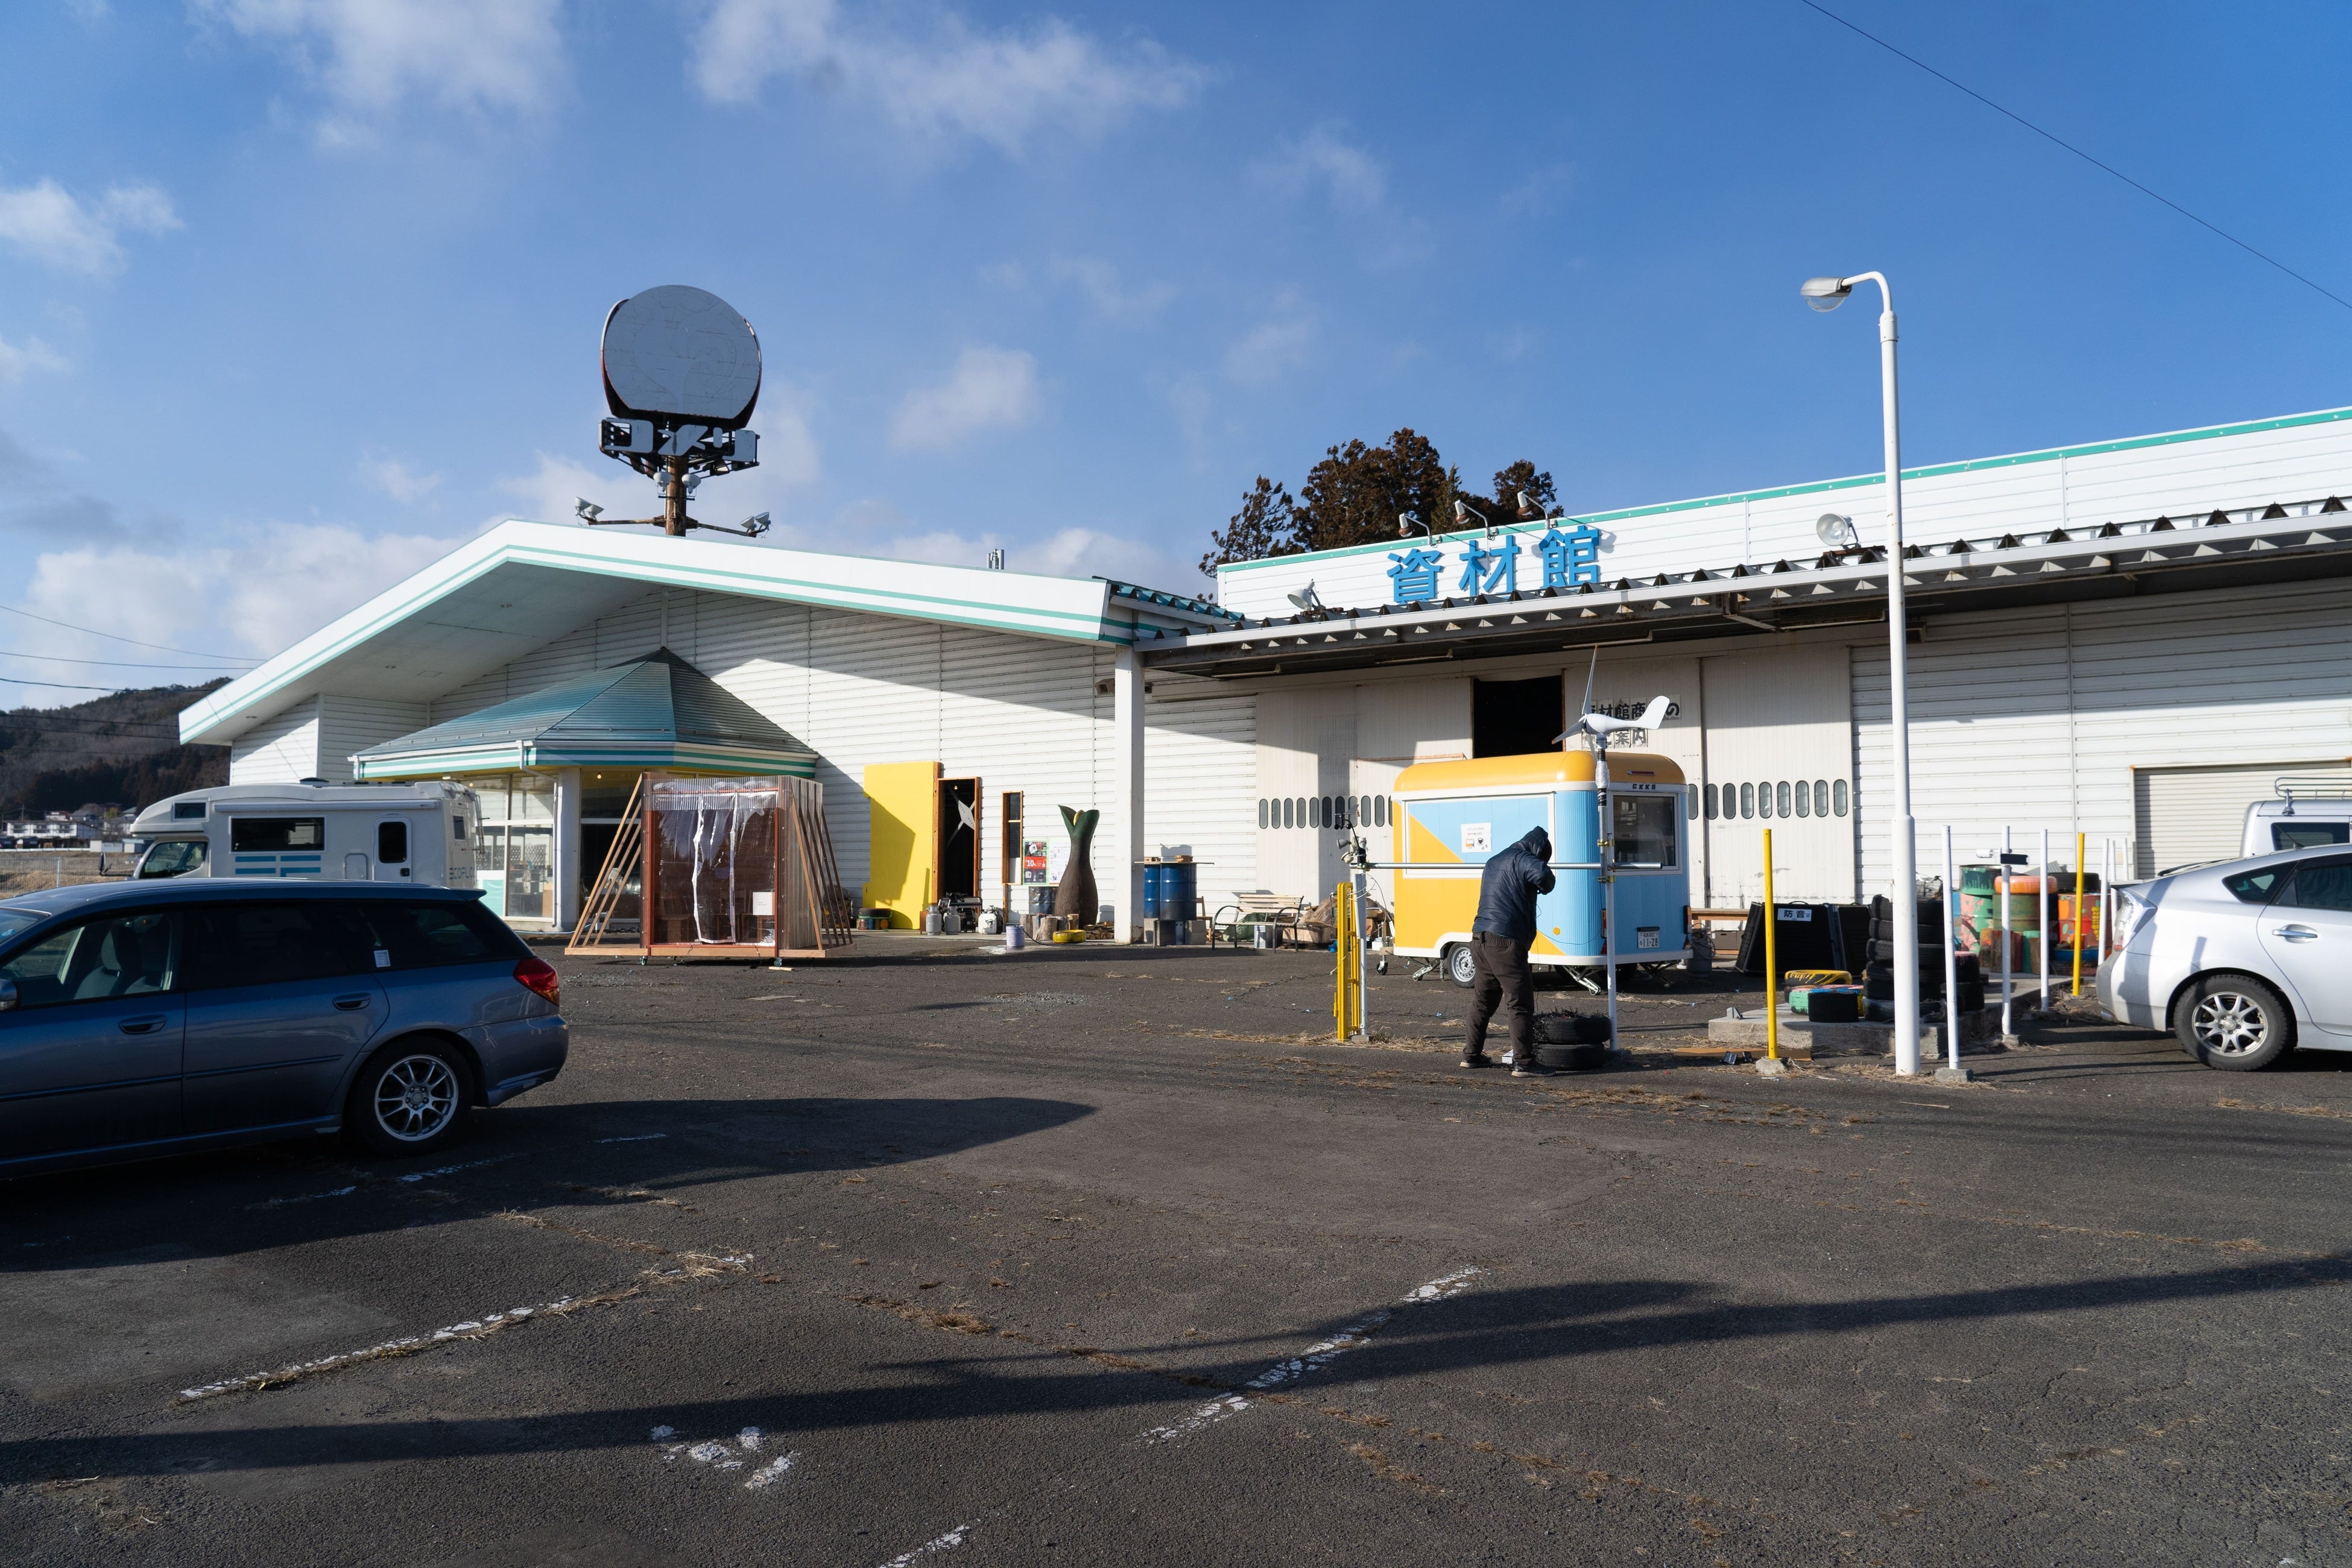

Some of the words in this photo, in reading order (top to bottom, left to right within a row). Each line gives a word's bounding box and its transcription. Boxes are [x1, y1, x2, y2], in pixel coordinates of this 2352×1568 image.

[1387, 525, 1599, 605] 資材館
[1590, 701, 1680, 721] 材館商の
[449, 867, 475, 879] ECOFLO
[1783, 909, 1806, 918] 防音
